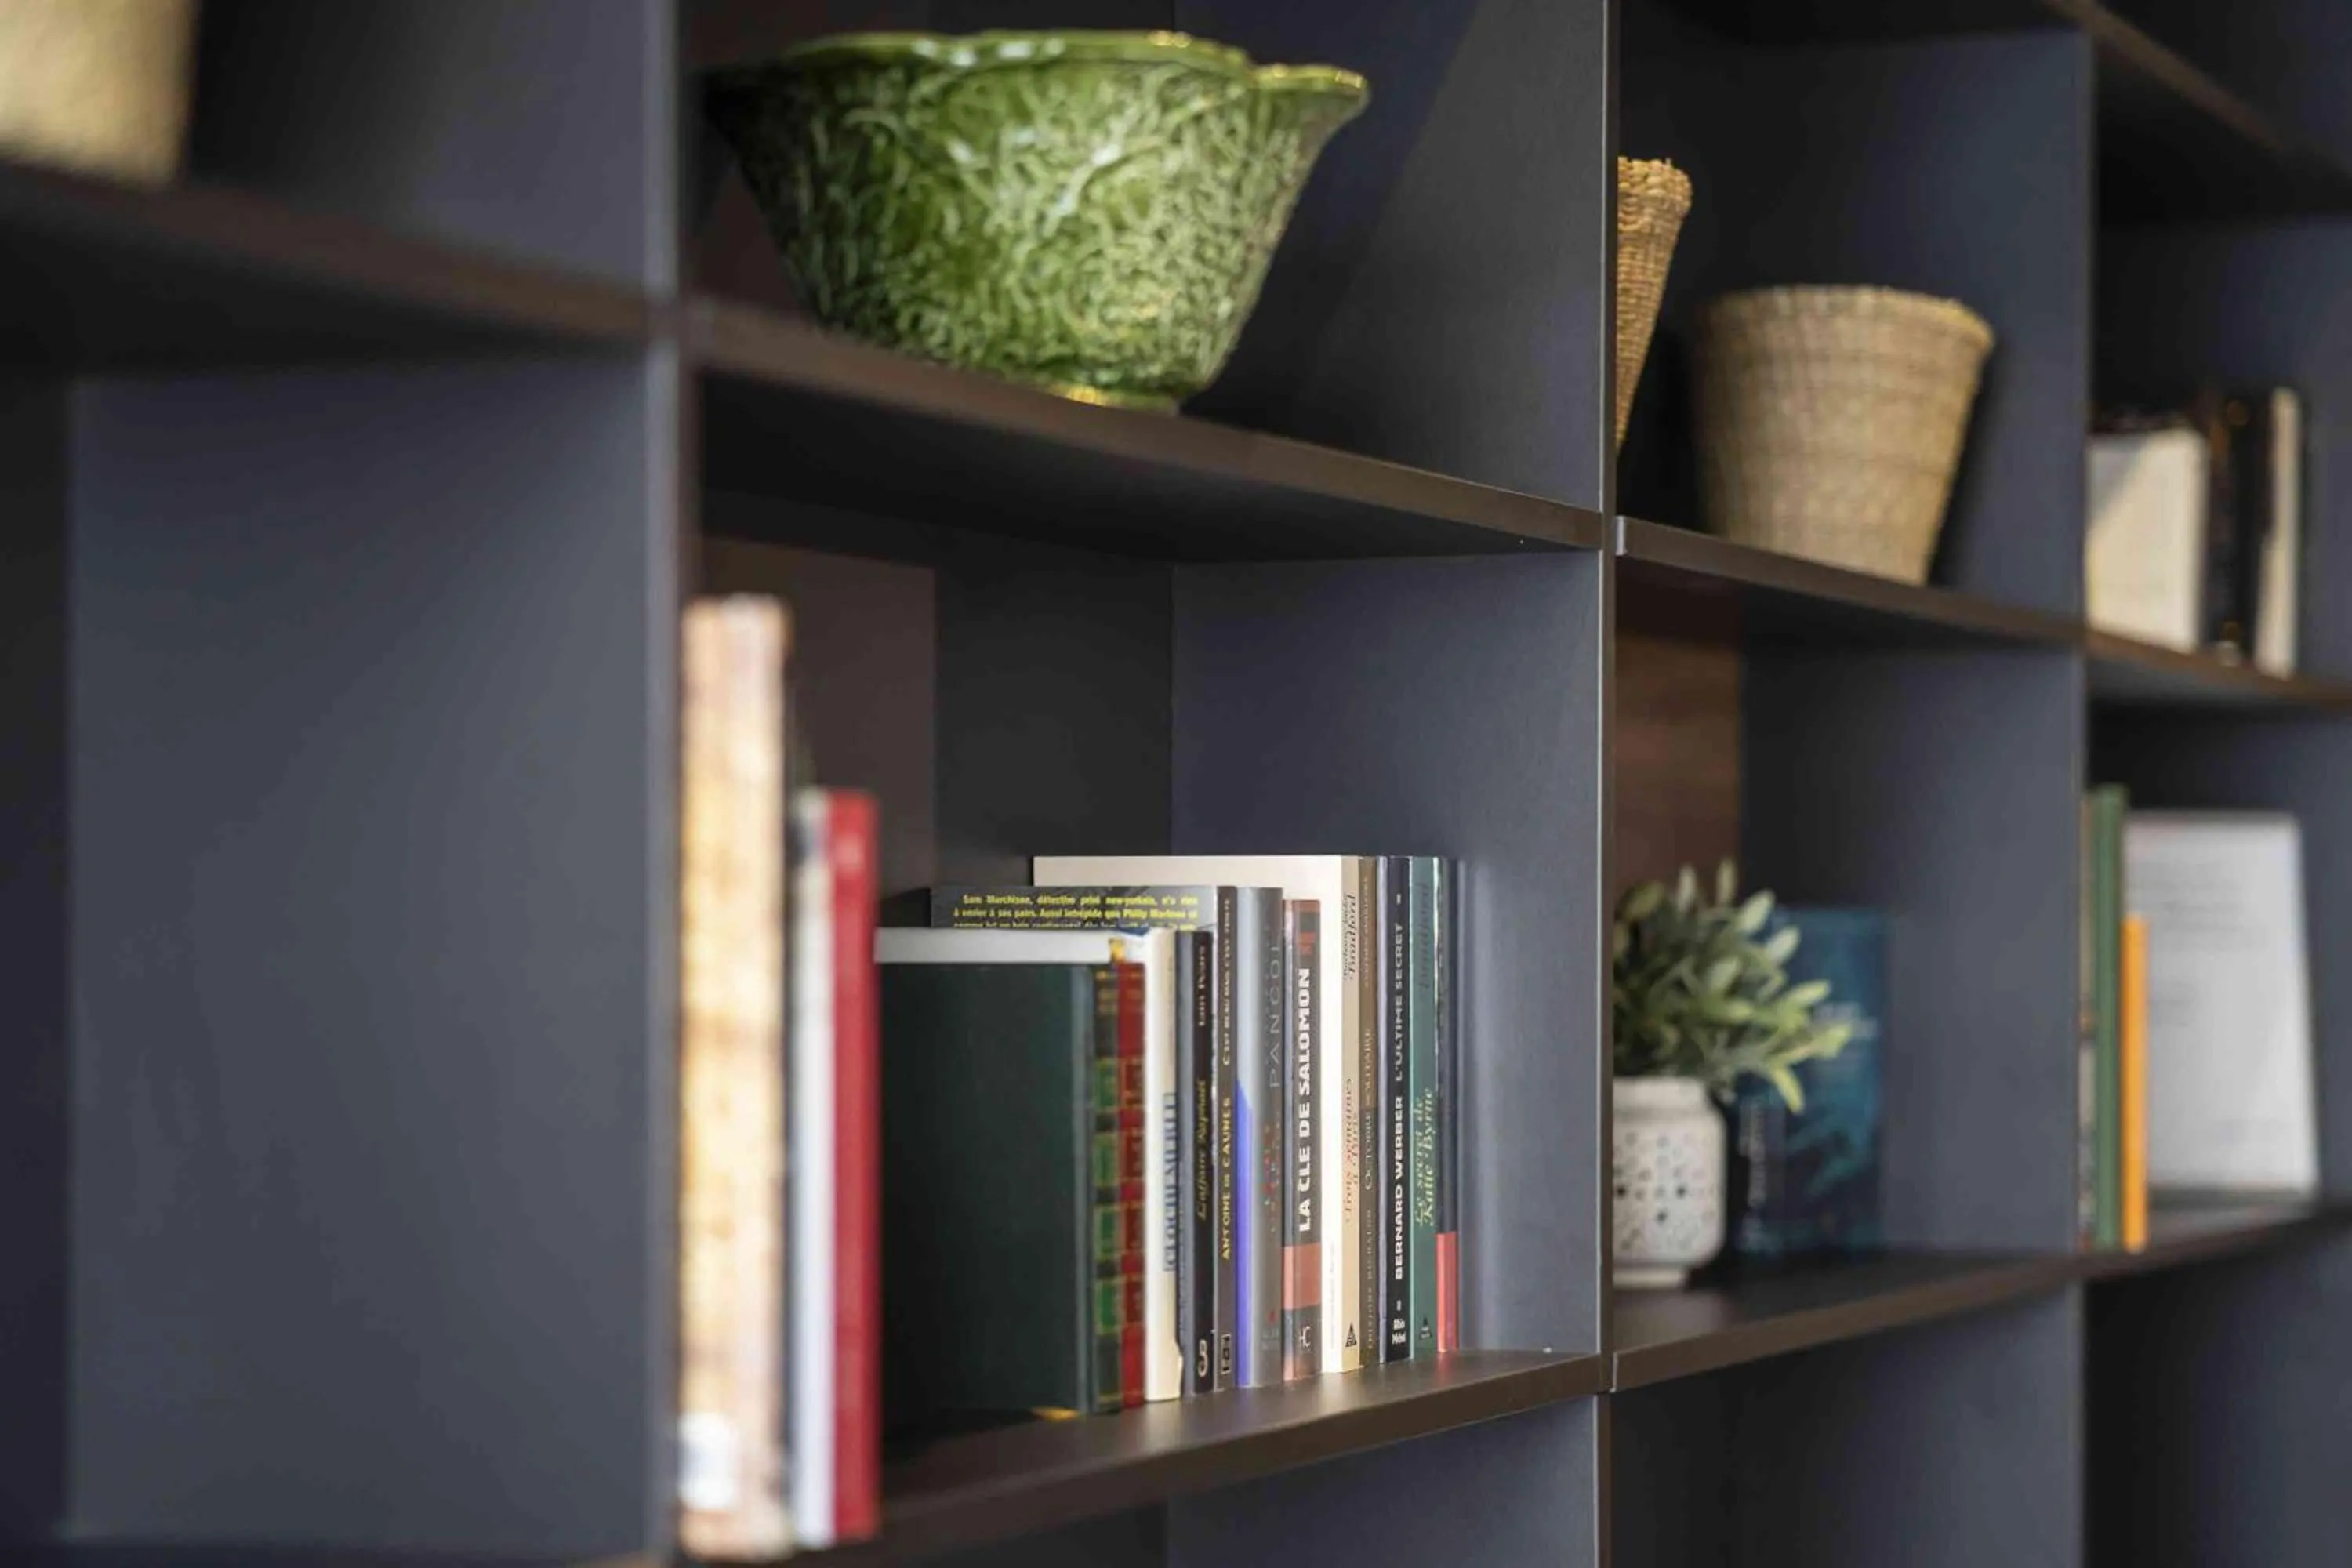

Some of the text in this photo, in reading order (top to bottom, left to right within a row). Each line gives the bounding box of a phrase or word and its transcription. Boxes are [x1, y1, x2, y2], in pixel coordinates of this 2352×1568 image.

[1269, 937, 1281, 1088] PANCOL
[1298, 967, 1311, 1095] SALOMON
[1395, 922, 1403, 1082] L'ULTIME SECRET
[1221, 1098, 1231, 1168] CAUNES
[1298, 1102, 1312, 1138] DE
[1412, 1097, 1424, 1123] de
[1394, 1096, 1403, 1281] BERNARD WERBER
[1414, 1129, 1424, 1189] secret
[1221, 1191, 1231, 1260] ANTOINE
[1298, 1198, 1312, 1232] LA
